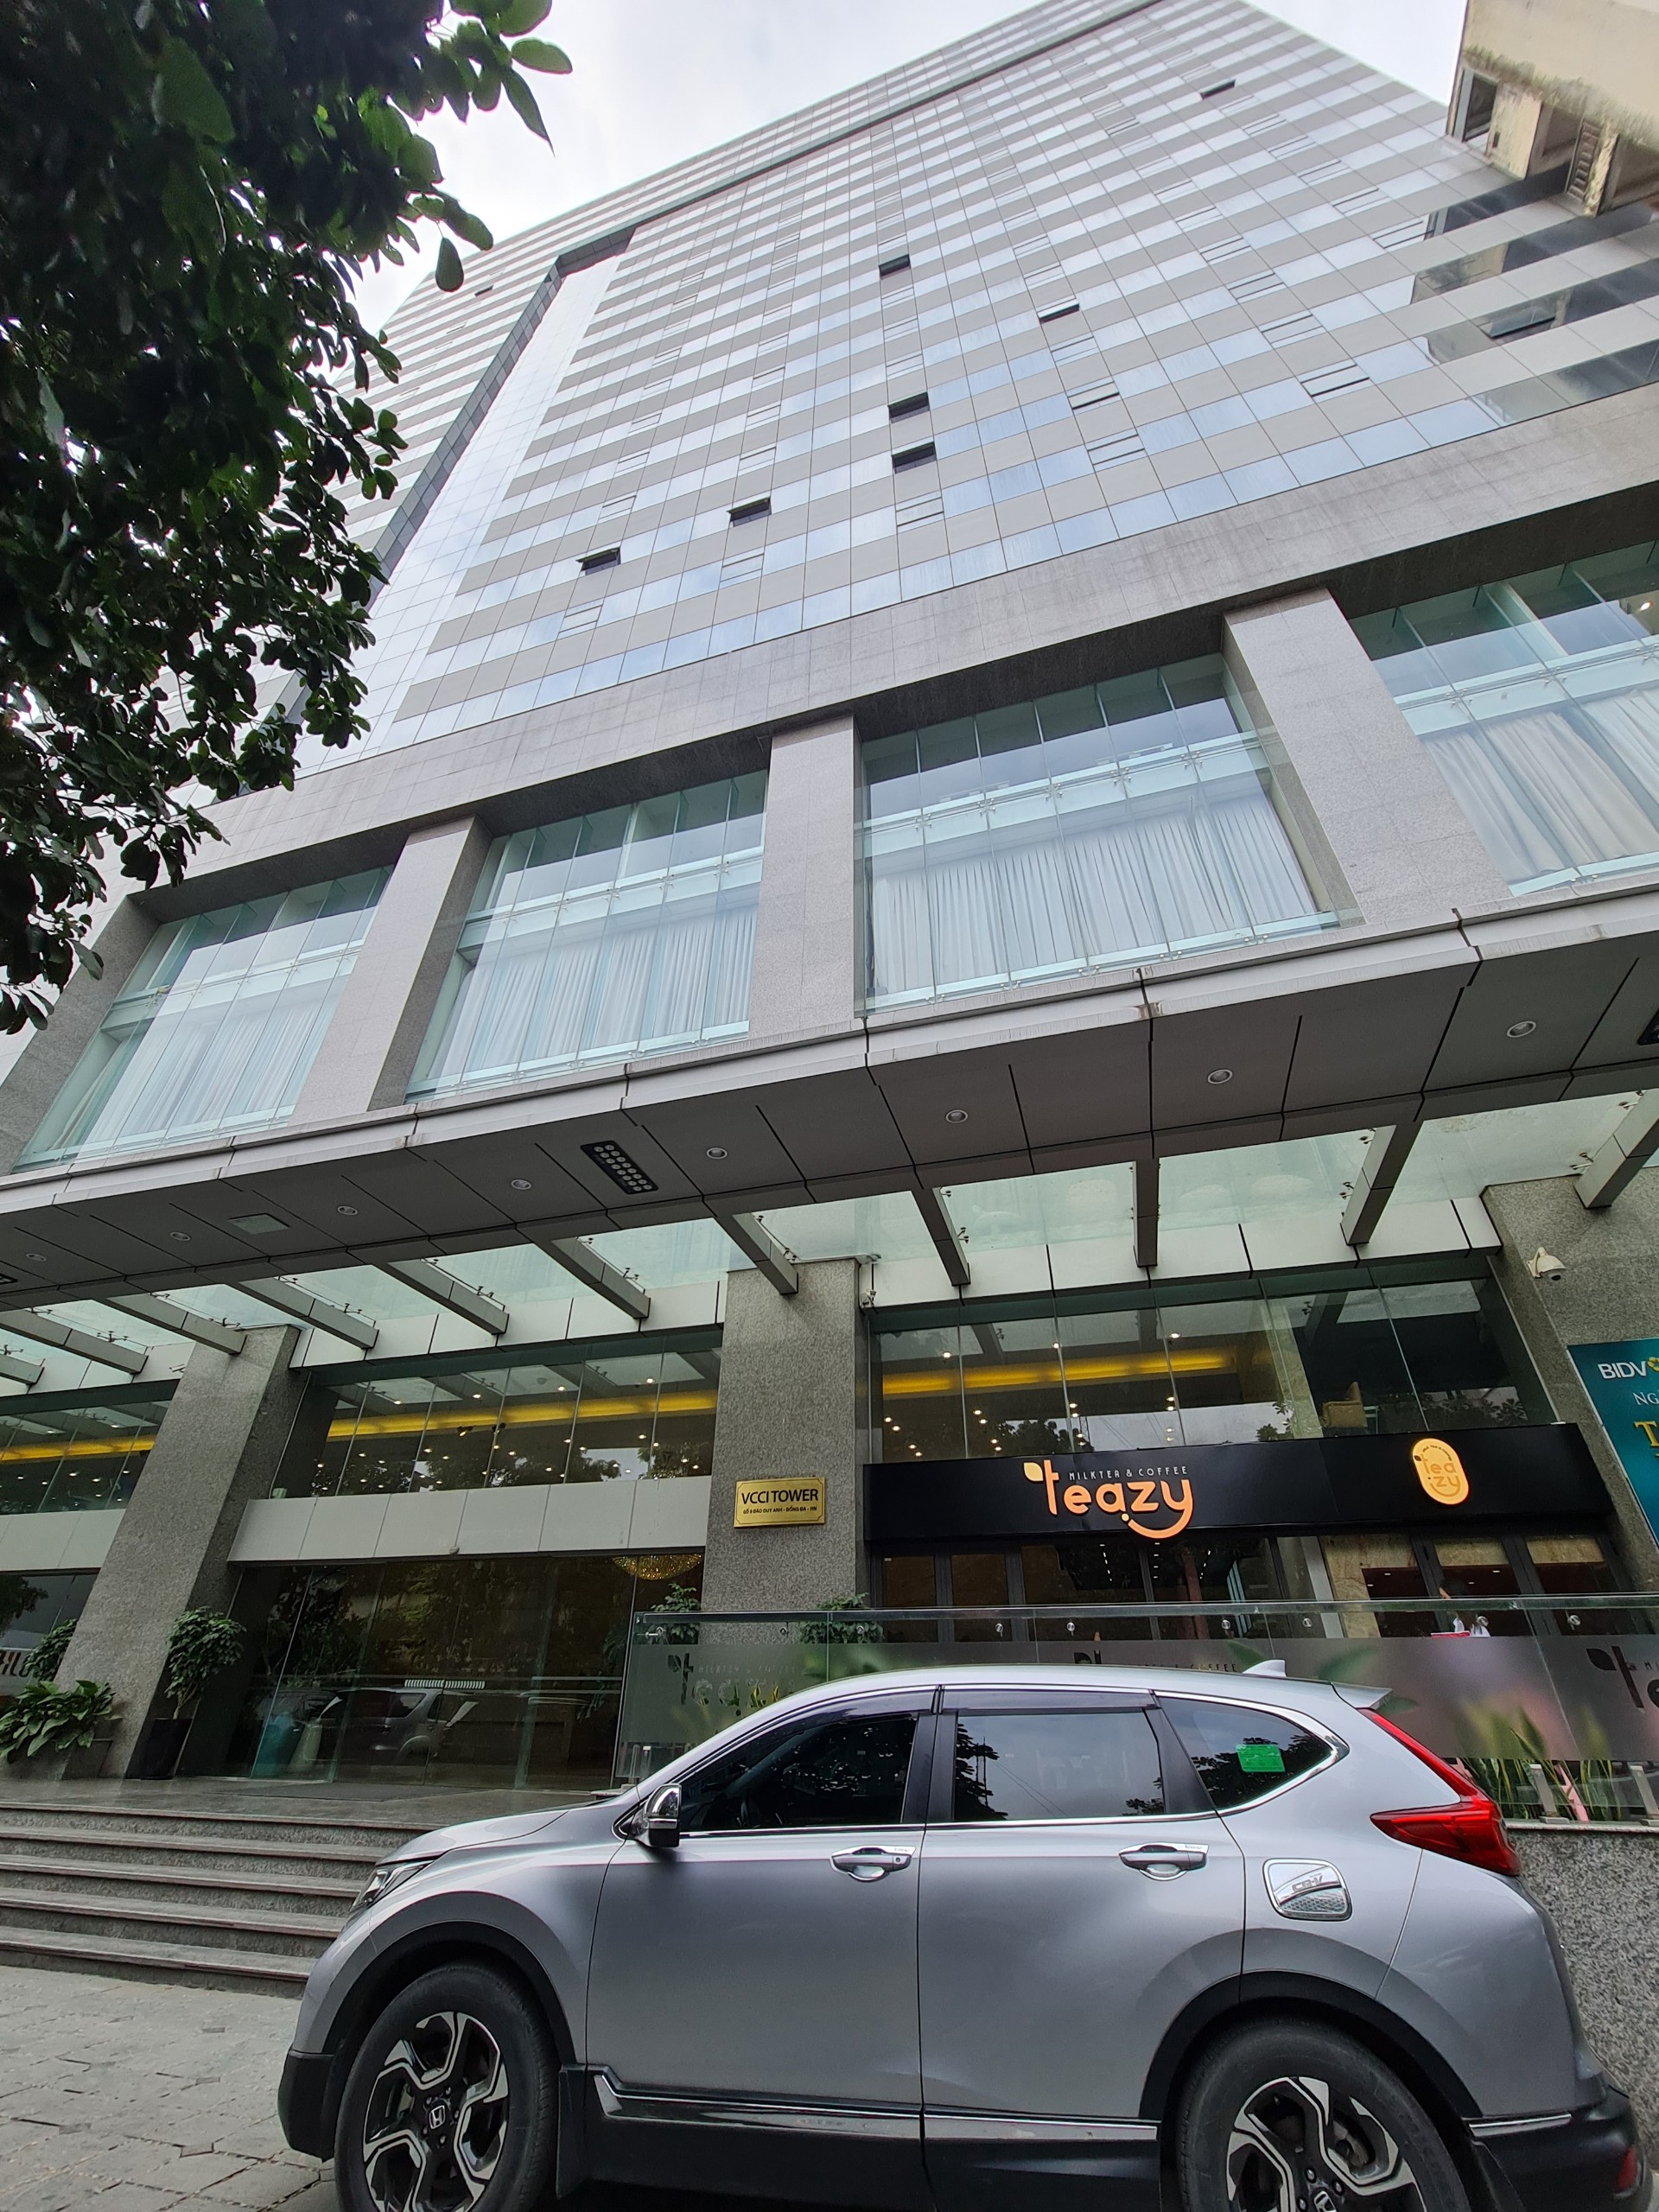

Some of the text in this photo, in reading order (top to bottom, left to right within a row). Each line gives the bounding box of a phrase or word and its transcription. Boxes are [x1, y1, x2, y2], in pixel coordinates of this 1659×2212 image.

[1598, 1361, 1647, 1379] BIDV
[1632, 1389, 1659, 1406] NG
[1068, 1465, 1188, 1482] MILKTEA & COFFEE
[741, 1489, 819, 1504] VCCI TOWER
[1043, 1459, 1194, 1539] teazy
[1292, 1875, 1323, 1892] CR-V
